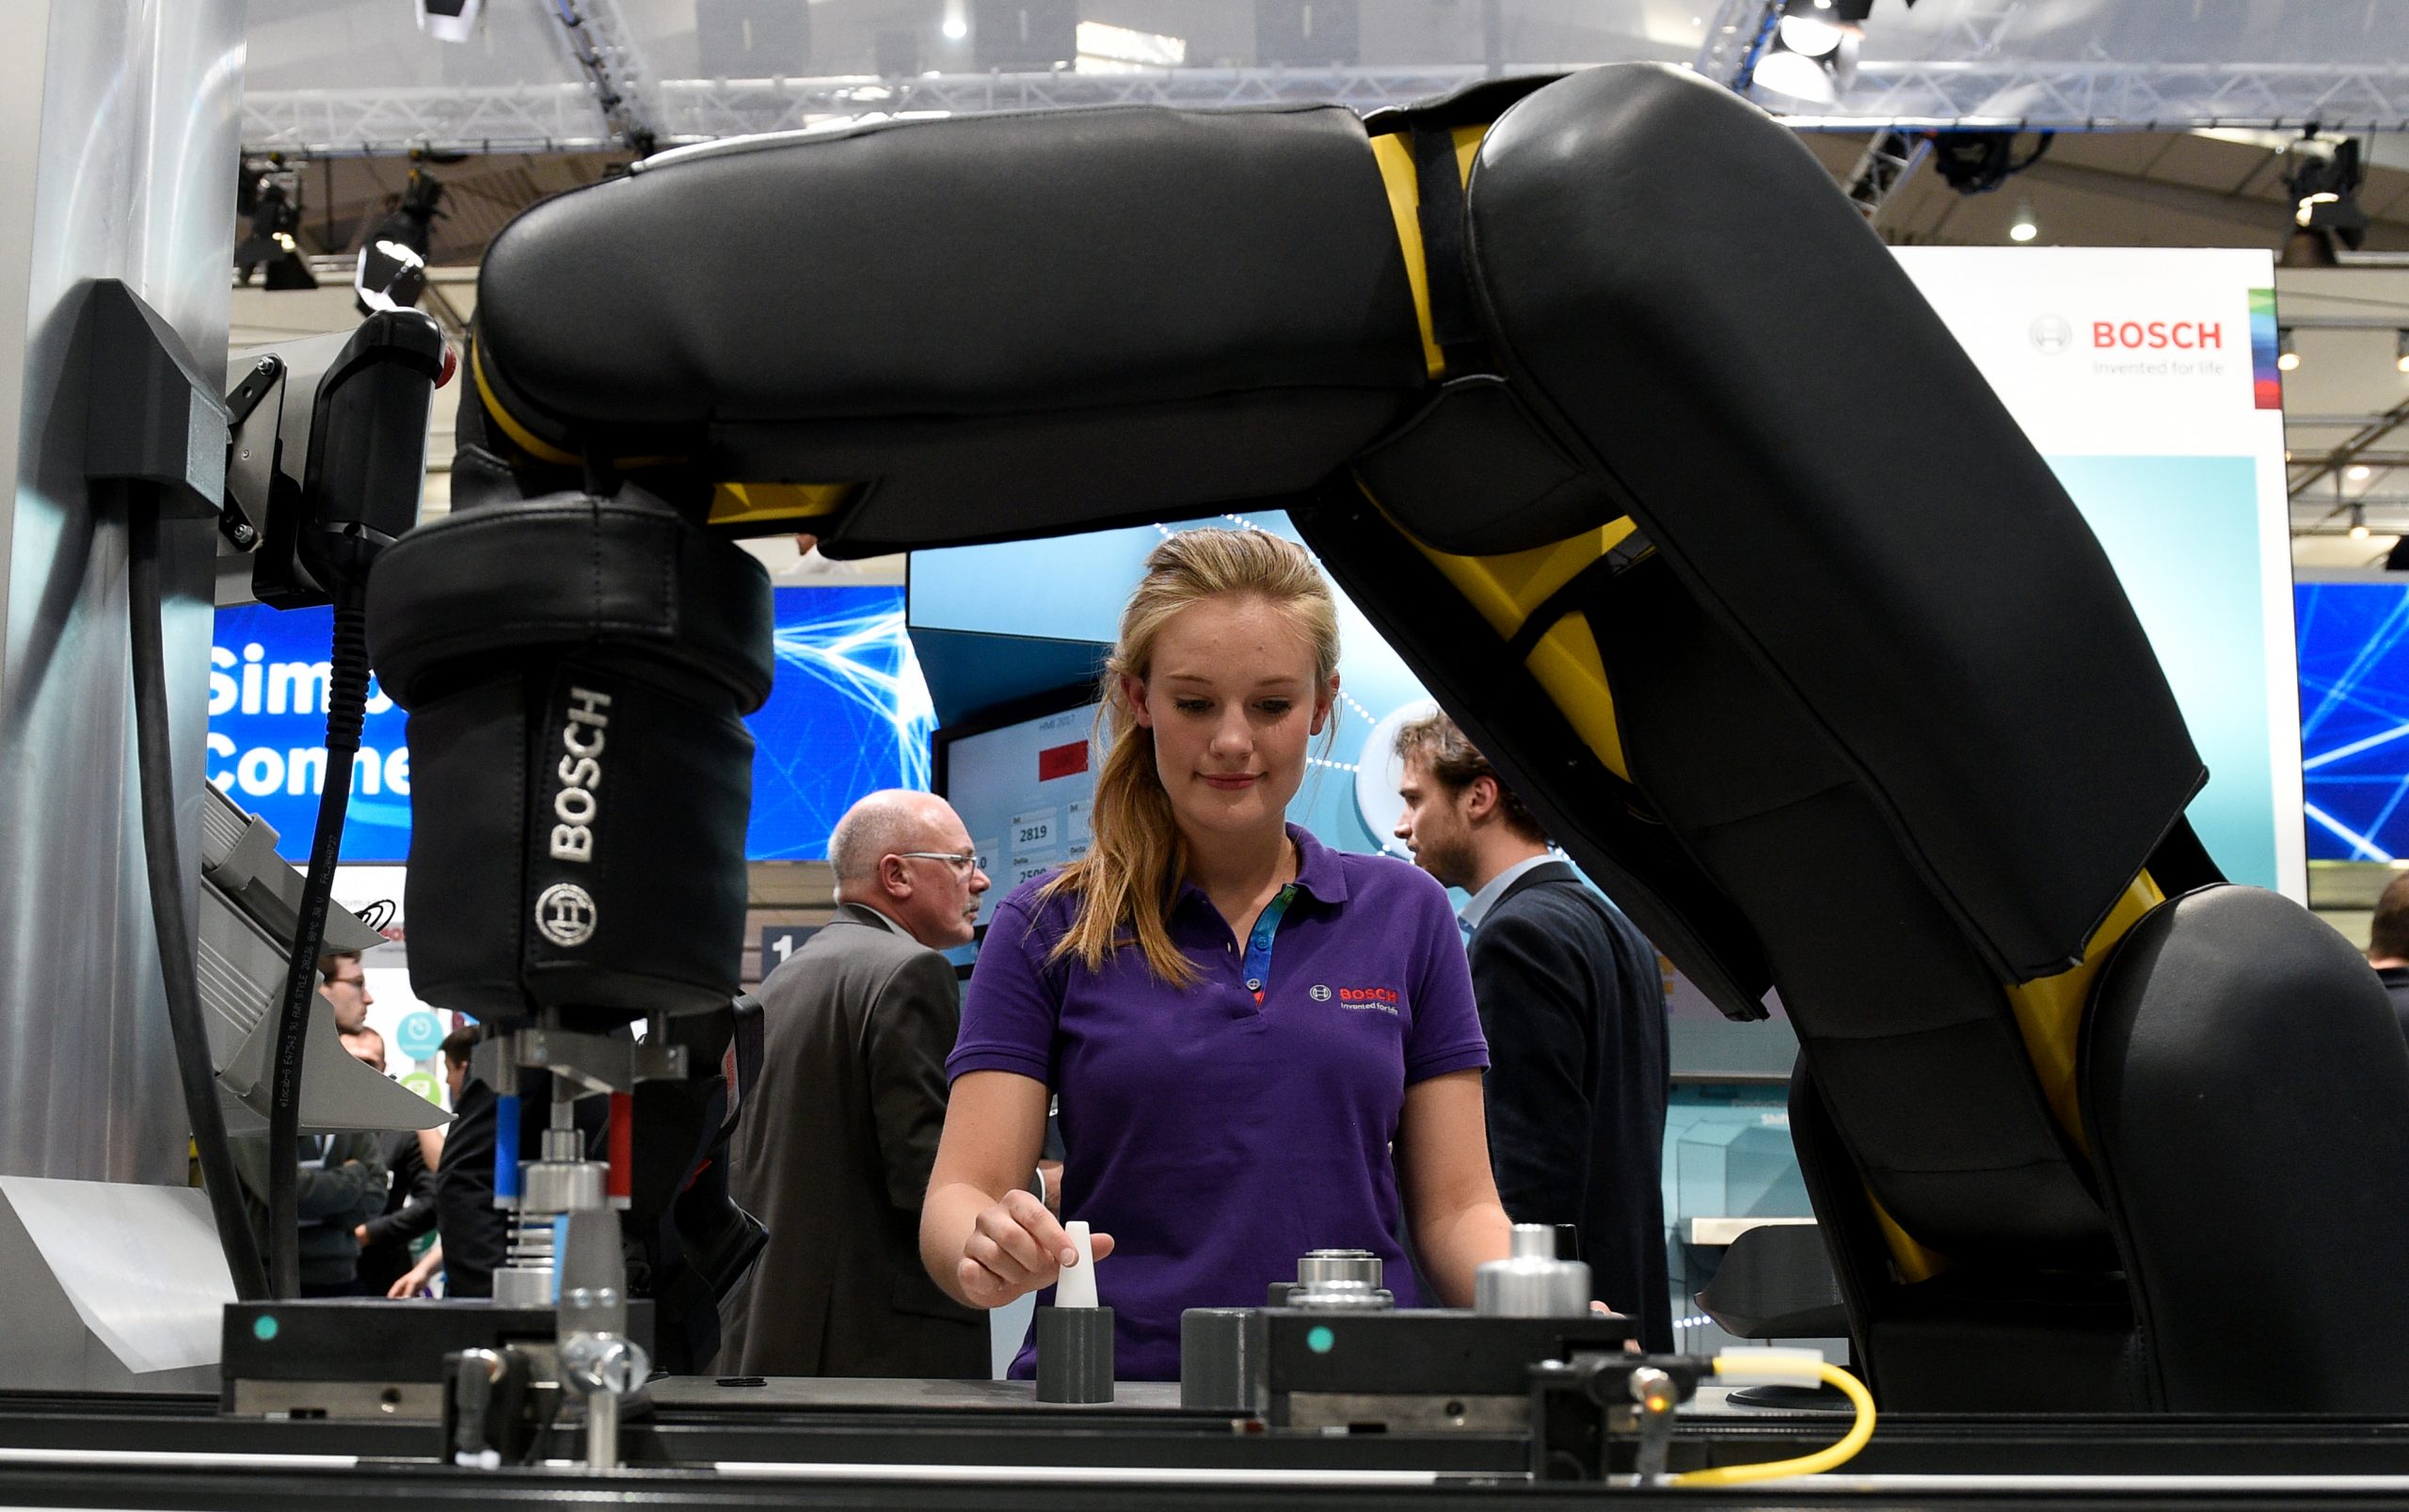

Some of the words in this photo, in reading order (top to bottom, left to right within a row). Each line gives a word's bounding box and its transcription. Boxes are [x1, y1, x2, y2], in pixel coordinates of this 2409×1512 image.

[2093, 321, 2222, 349] BOSCH
[2094, 360, 2167, 374] Invented
[2172, 359, 2194, 374] for
[2199, 360, 2224, 374] life
[550, 686, 612, 863] BOSCH
[1020, 825, 1047, 843] 2819
[295, 973, 309, 997] STYLE
[1339, 987, 1399, 1004] BOSCH
